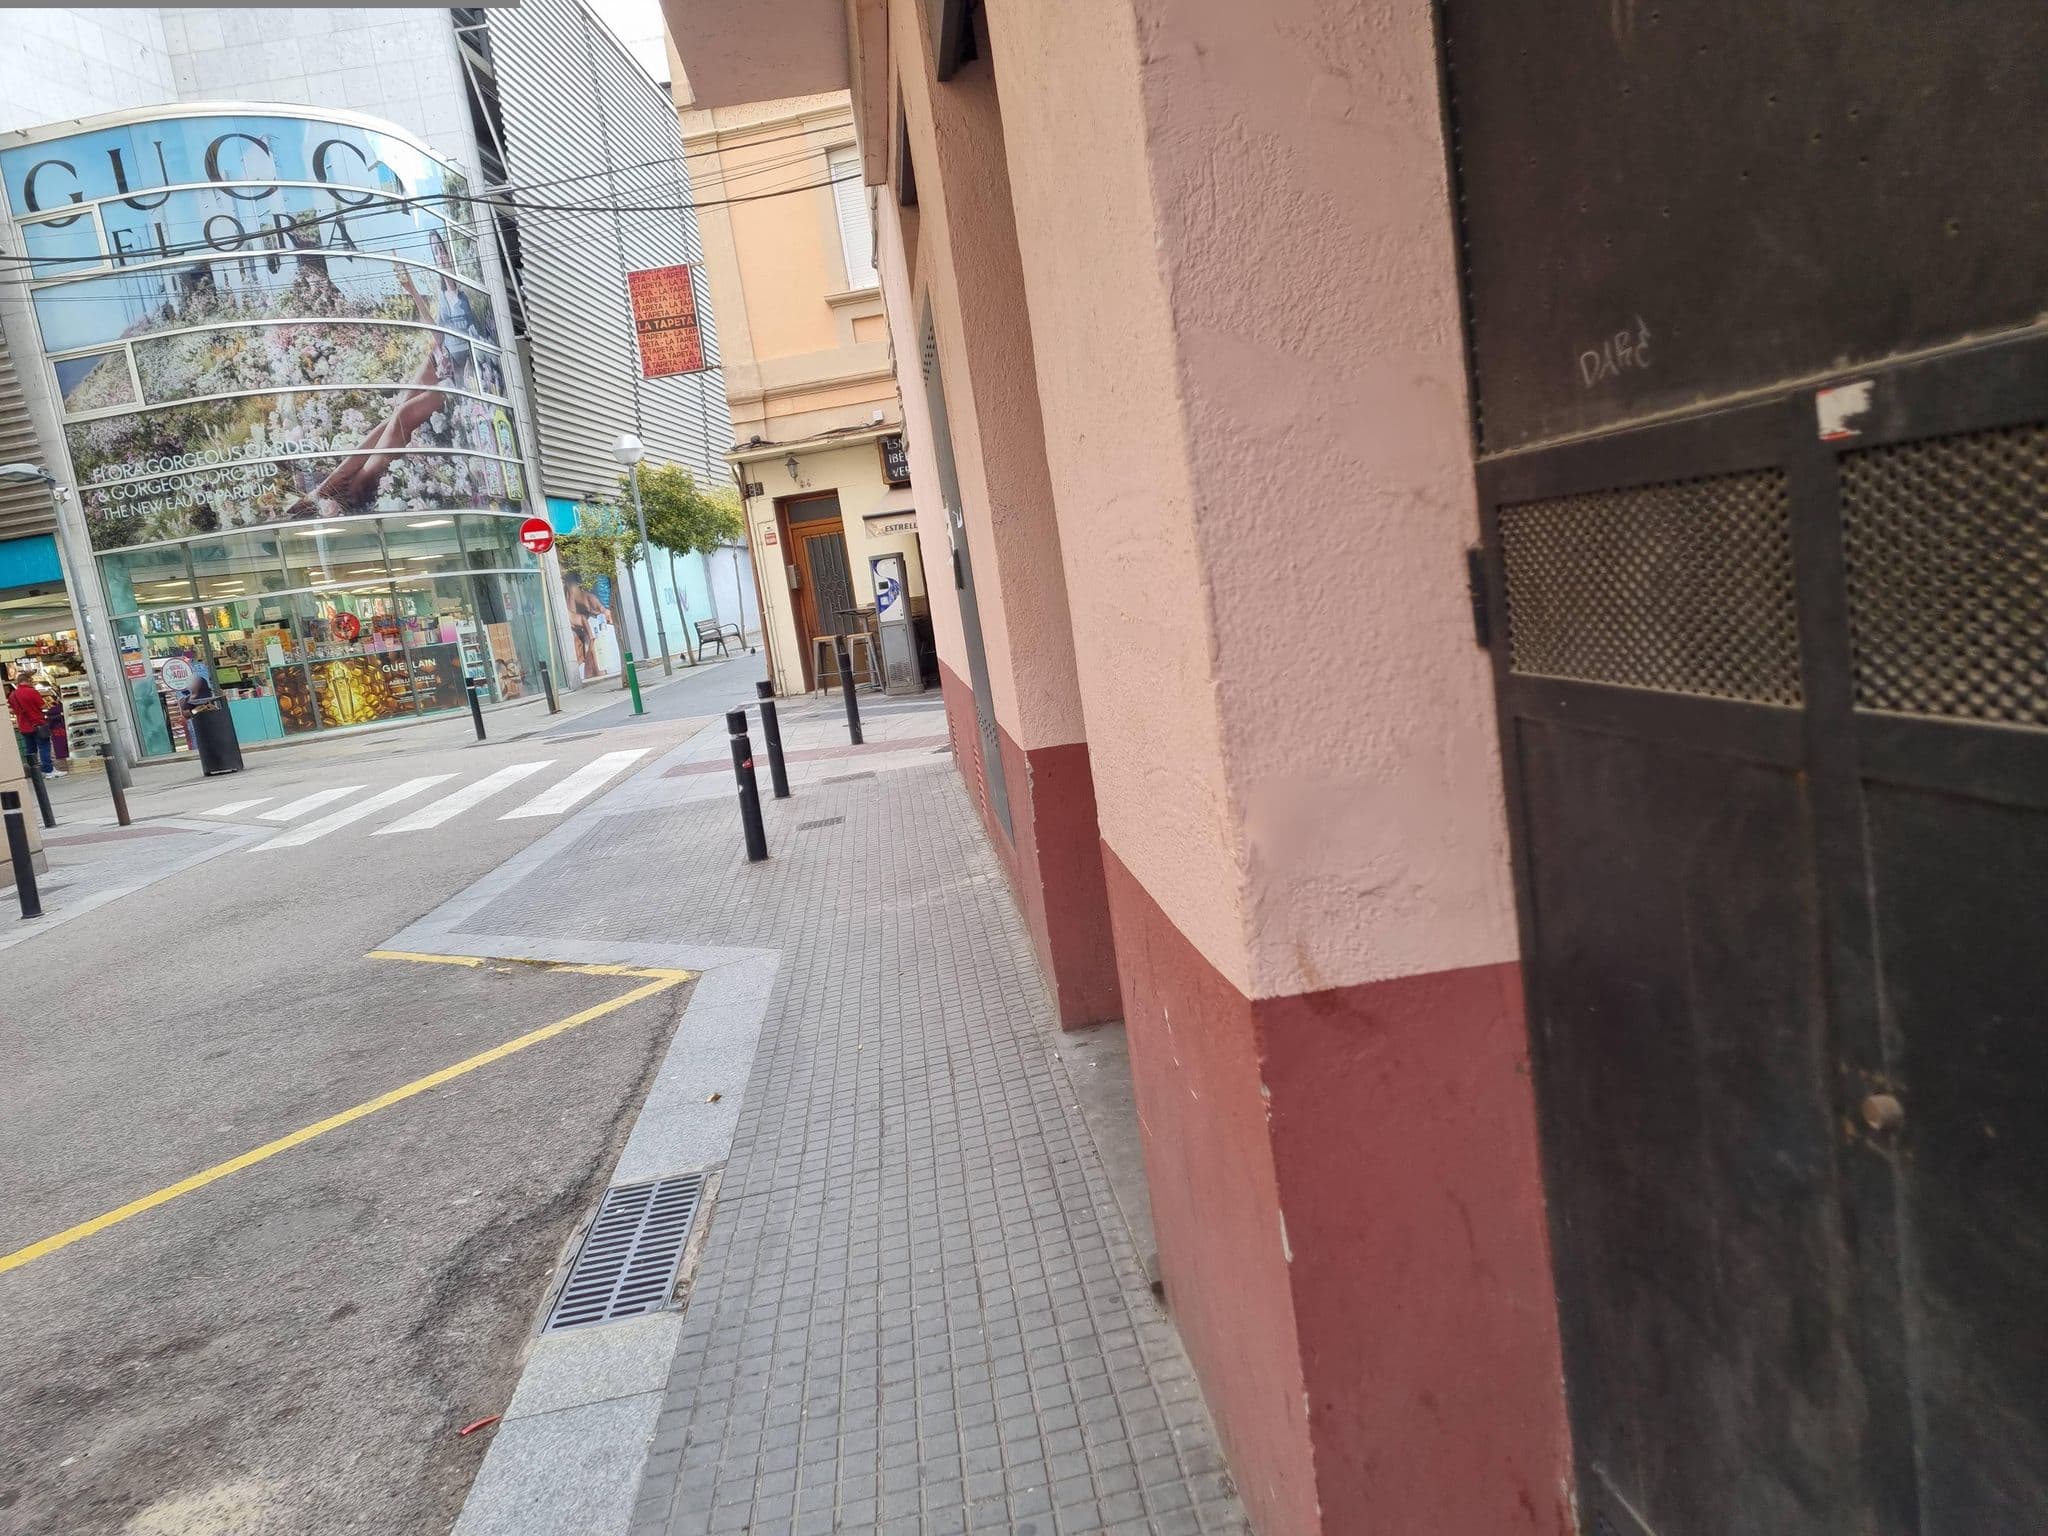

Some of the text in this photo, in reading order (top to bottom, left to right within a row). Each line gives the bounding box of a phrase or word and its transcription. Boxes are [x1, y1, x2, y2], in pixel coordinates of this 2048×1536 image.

[112, 213, 356, 266] FLORA
[637, 315, 693, 332] LA TAPETA
[644, 309, 669, 319] TAPETA
[93, 438, 343, 484] FLORA GORGEOUS GARDENIA
[98, 461, 279, 503] & GORGEOUS ORCHID
[101, 502, 130, 521] THE
[130, 498, 164, 517] NEW
[165, 491, 194, 512] EAU
[382, 658, 437, 673] GUELAIN
